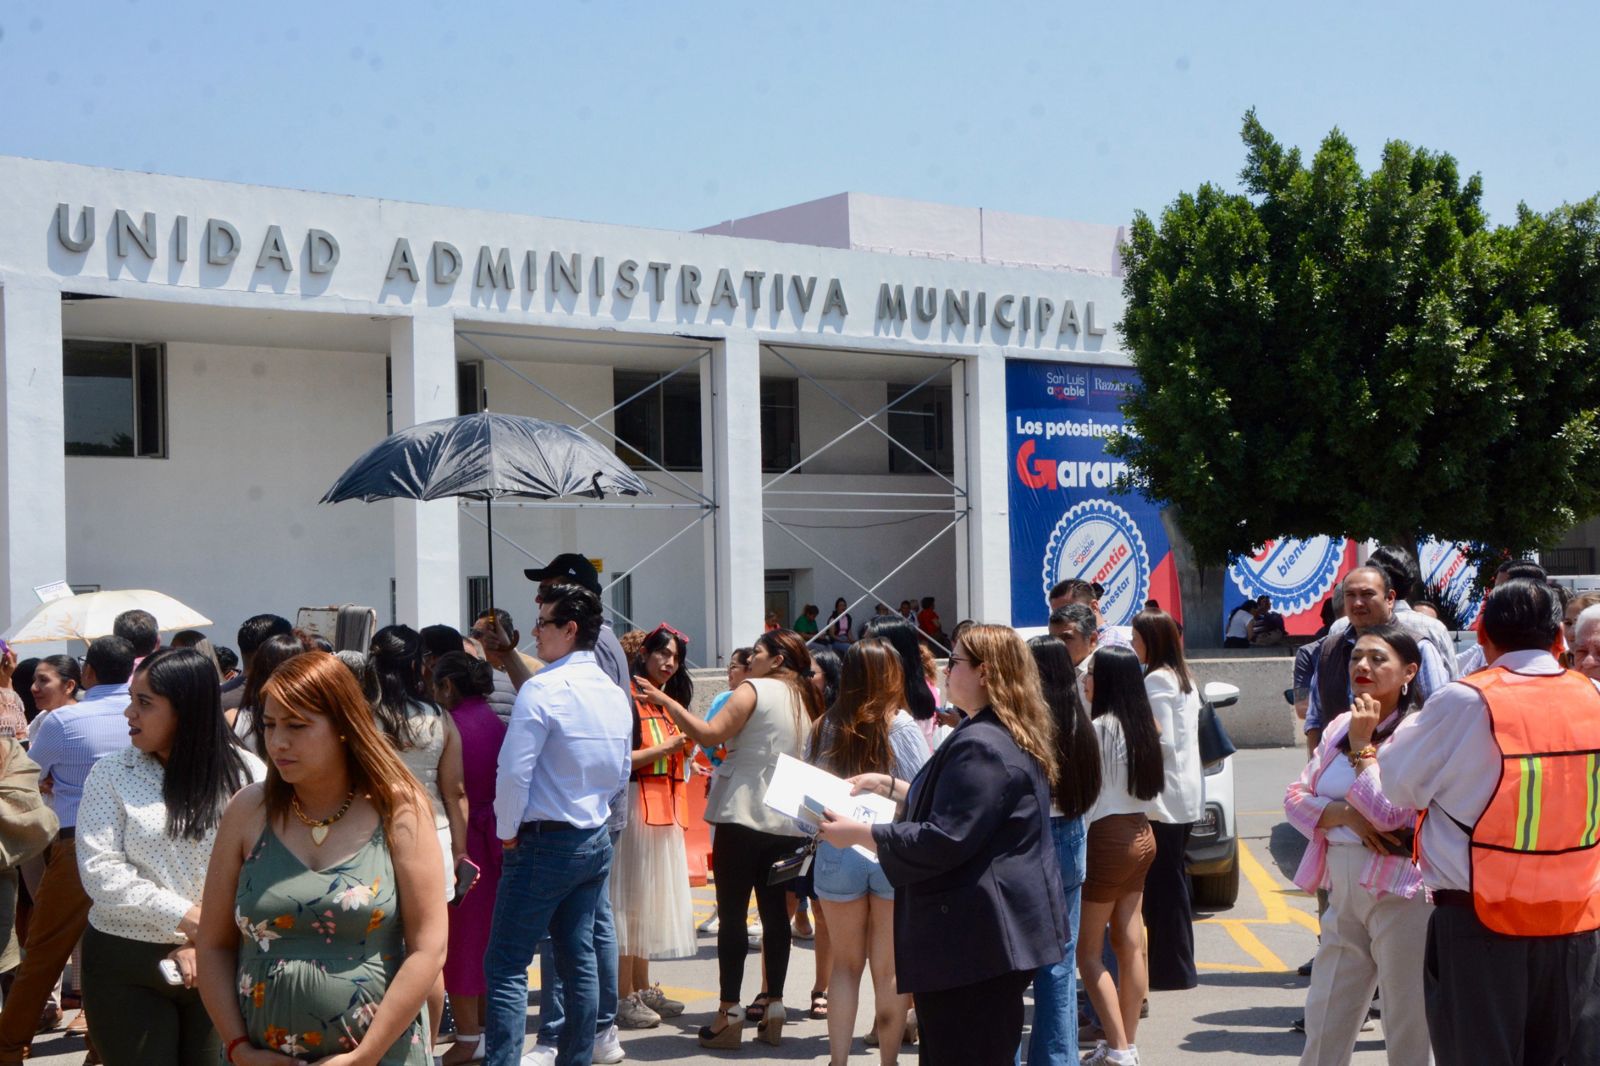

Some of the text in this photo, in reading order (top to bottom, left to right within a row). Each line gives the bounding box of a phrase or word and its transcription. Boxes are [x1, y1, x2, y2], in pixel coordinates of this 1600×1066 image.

[57, 203, 1107, 336] UNIDAD ADMINISTRATIVA MUNICIPAL
[1046, 372, 1085, 386] San Luis
[1016, 416, 1043, 435] Los
[1045, 418, 1119, 440] potosinos
[1090, 543, 1128, 587] rantía
[1100, 576, 1131, 615] enestar
